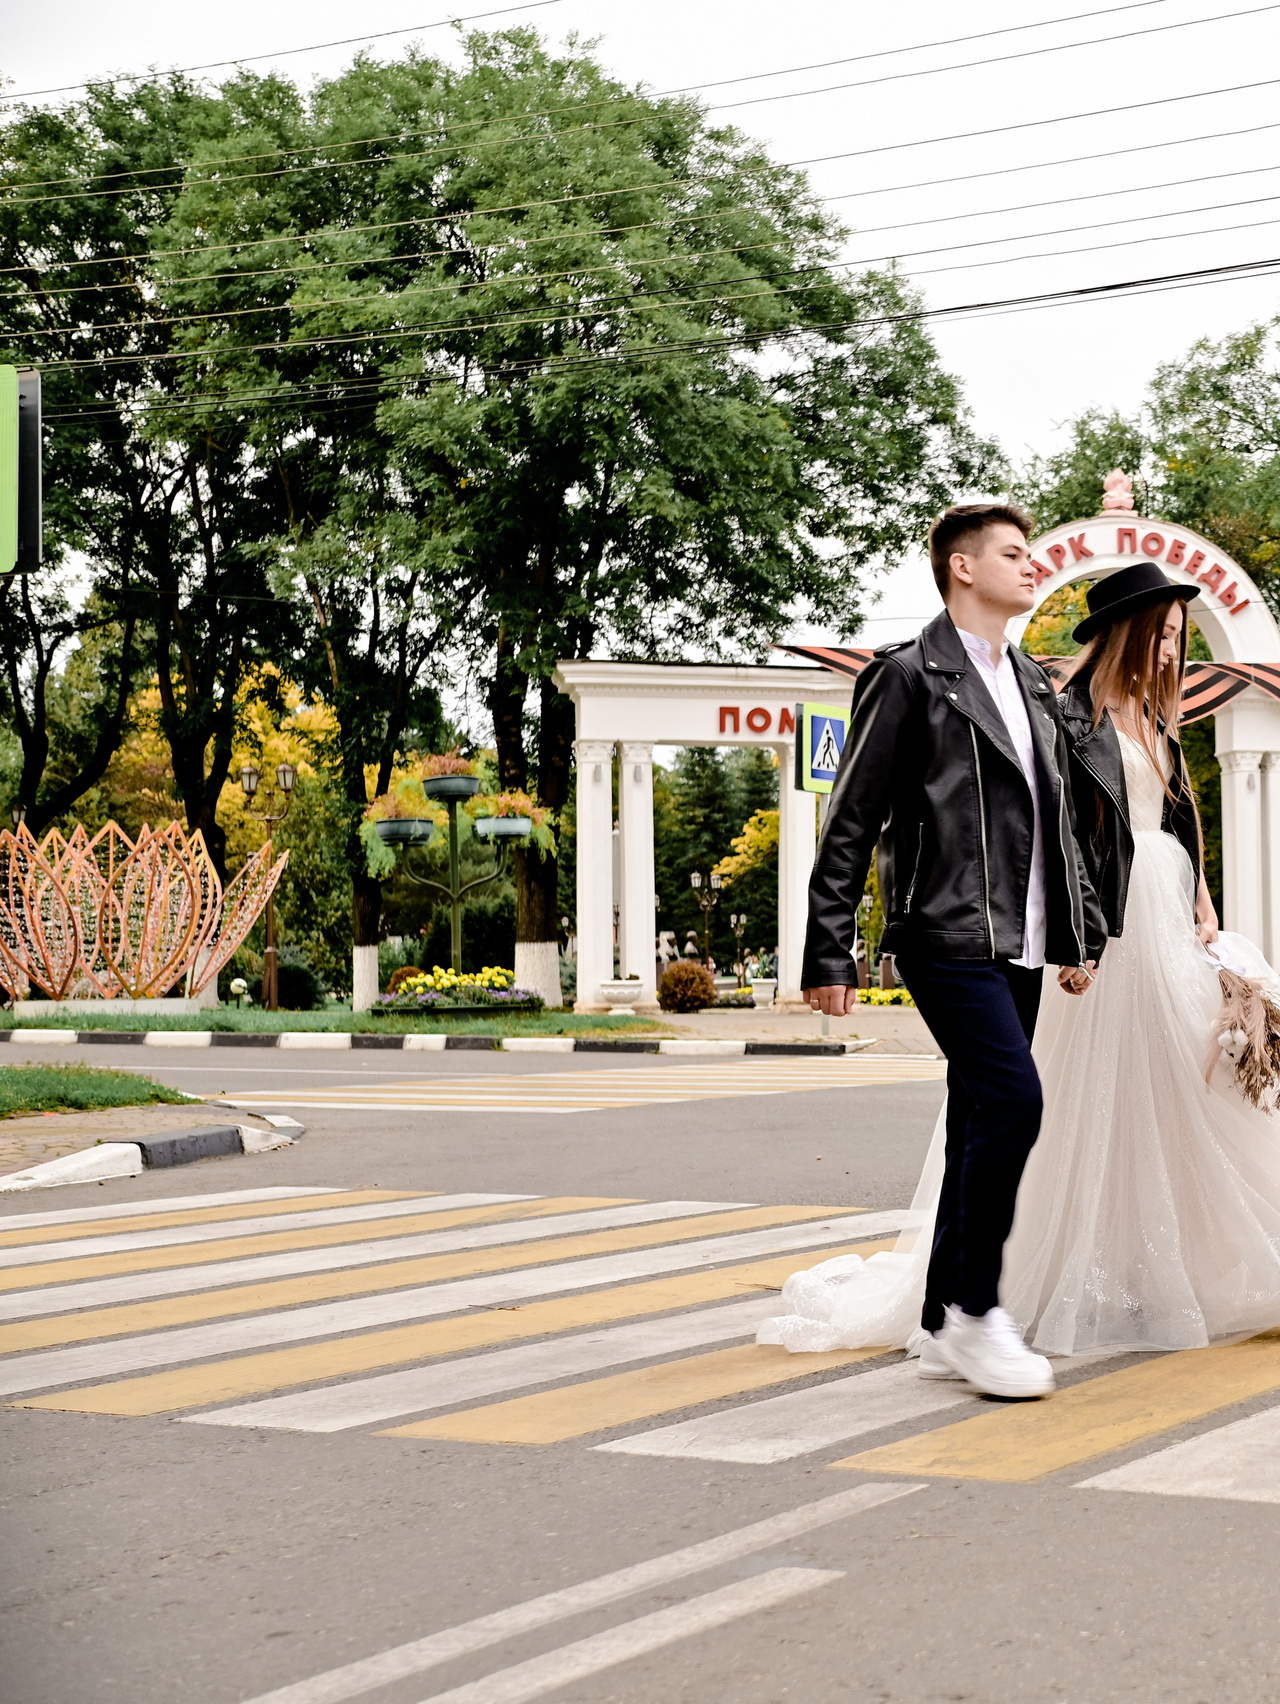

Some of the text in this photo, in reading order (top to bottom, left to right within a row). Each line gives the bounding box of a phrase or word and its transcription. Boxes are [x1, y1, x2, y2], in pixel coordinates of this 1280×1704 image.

[1030, 528, 1250, 615] АРК ПОБЕДЫ
[719, 706, 795, 734] ПОМ
